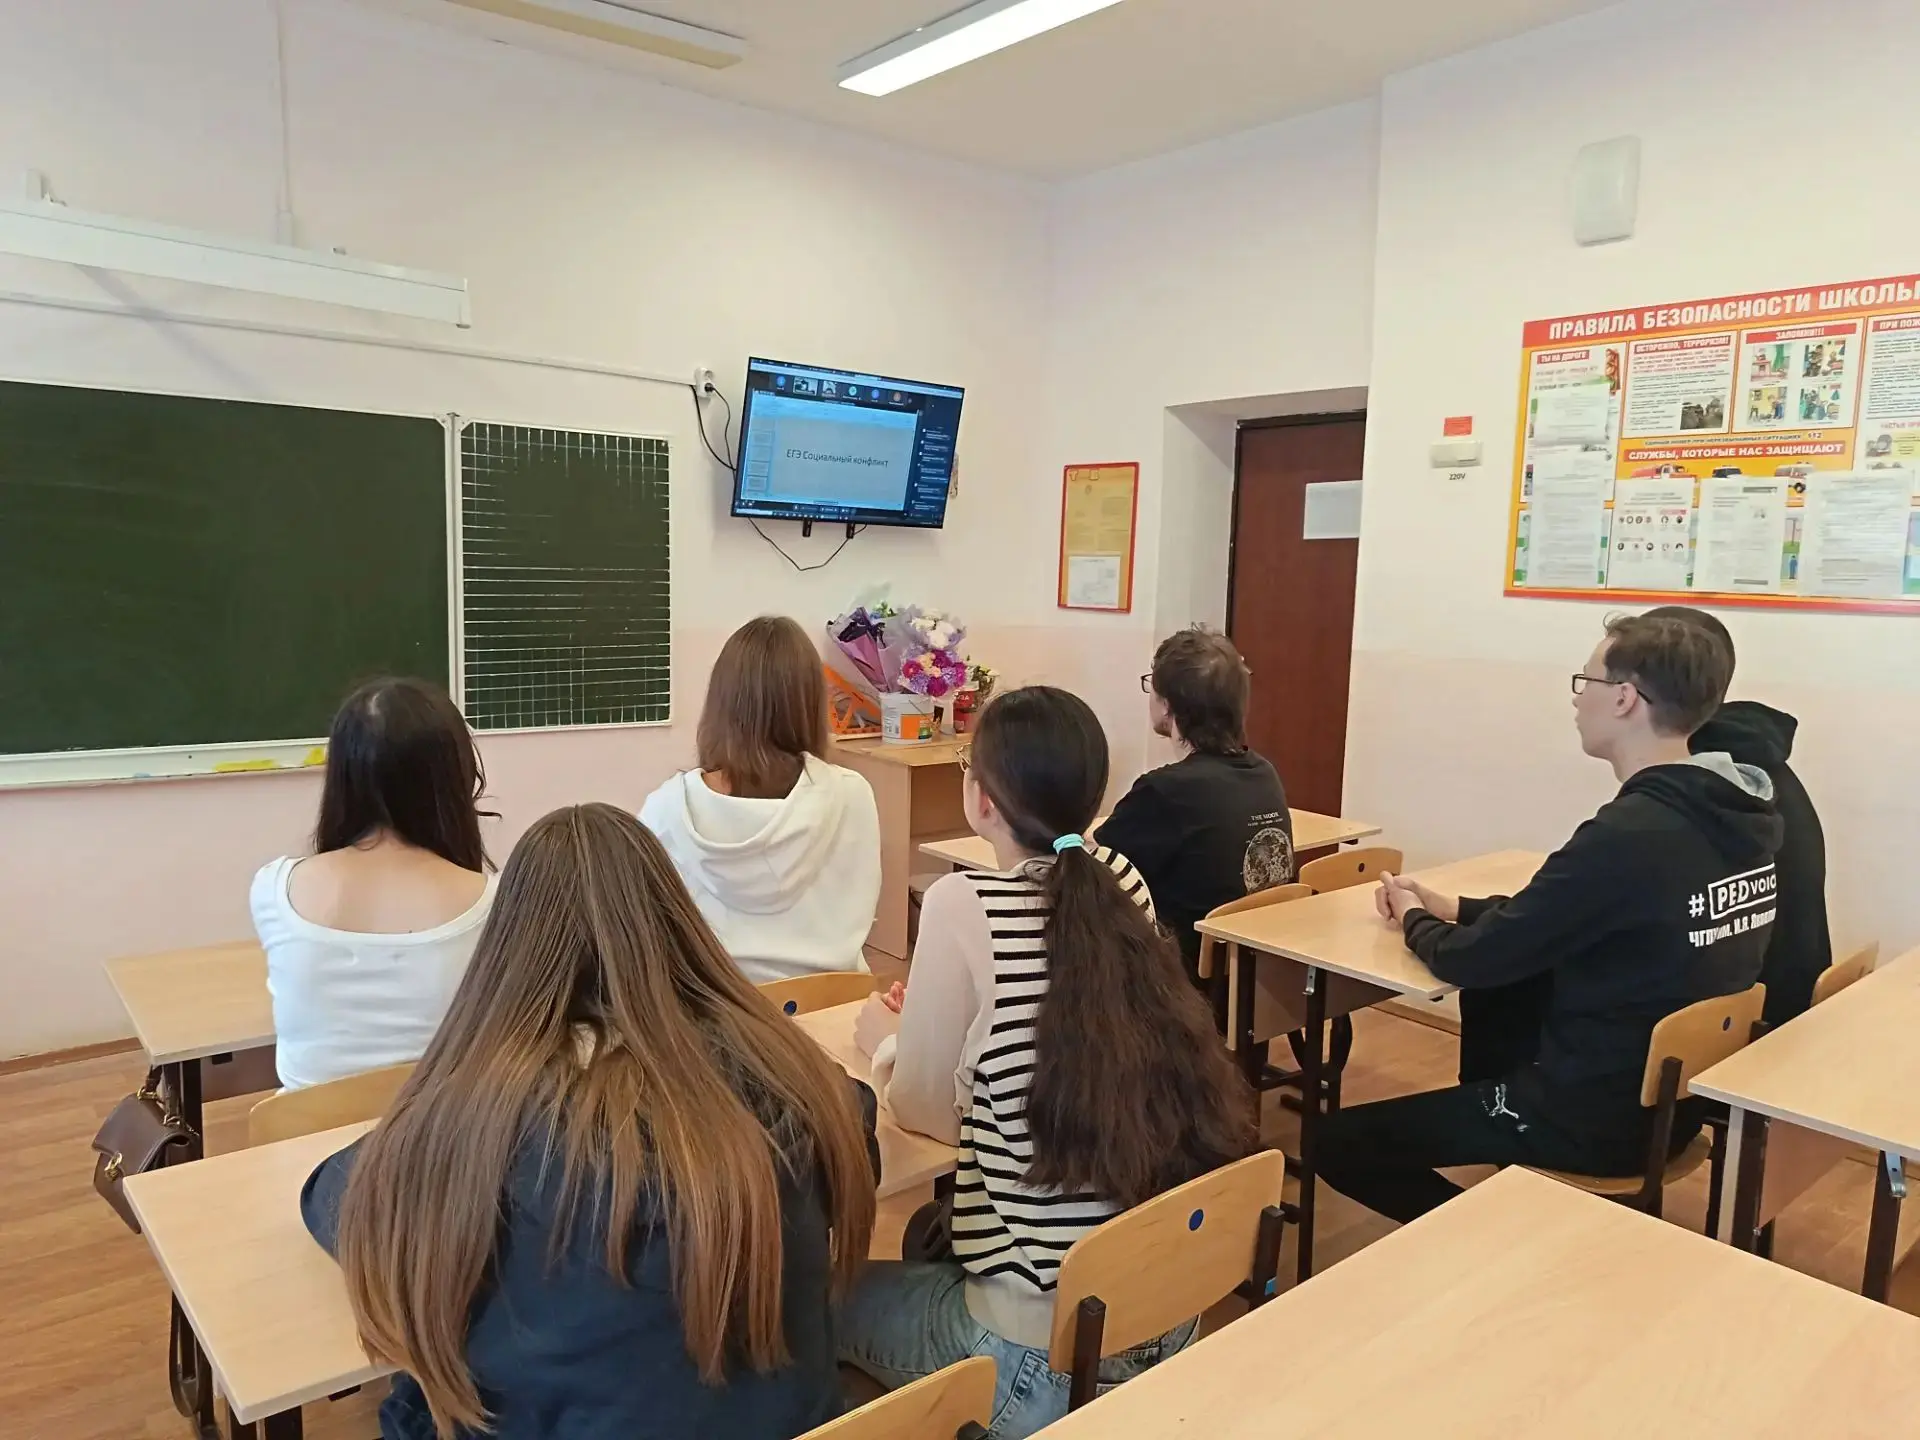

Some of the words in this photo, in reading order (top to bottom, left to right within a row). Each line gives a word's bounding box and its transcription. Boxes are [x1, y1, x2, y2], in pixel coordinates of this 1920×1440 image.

[1549, 313, 1637, 340] ПРАВИЛА
[1642, 292, 1812, 329] БЕЗОПАСНОСТИ
[786, 448, 801, 459] ЕГЭ
[803, 450, 852, 463] Социальный
[853, 456, 889, 468] конфликт
[1628, 450, 1679, 460] СЛУЖБЫ,
[1681, 447, 1736, 458] КОТОРЫЕ
[1738, 447, 1763, 456] НАС
[1766, 444, 1843, 455] ЗАЩИЩАЮТ
